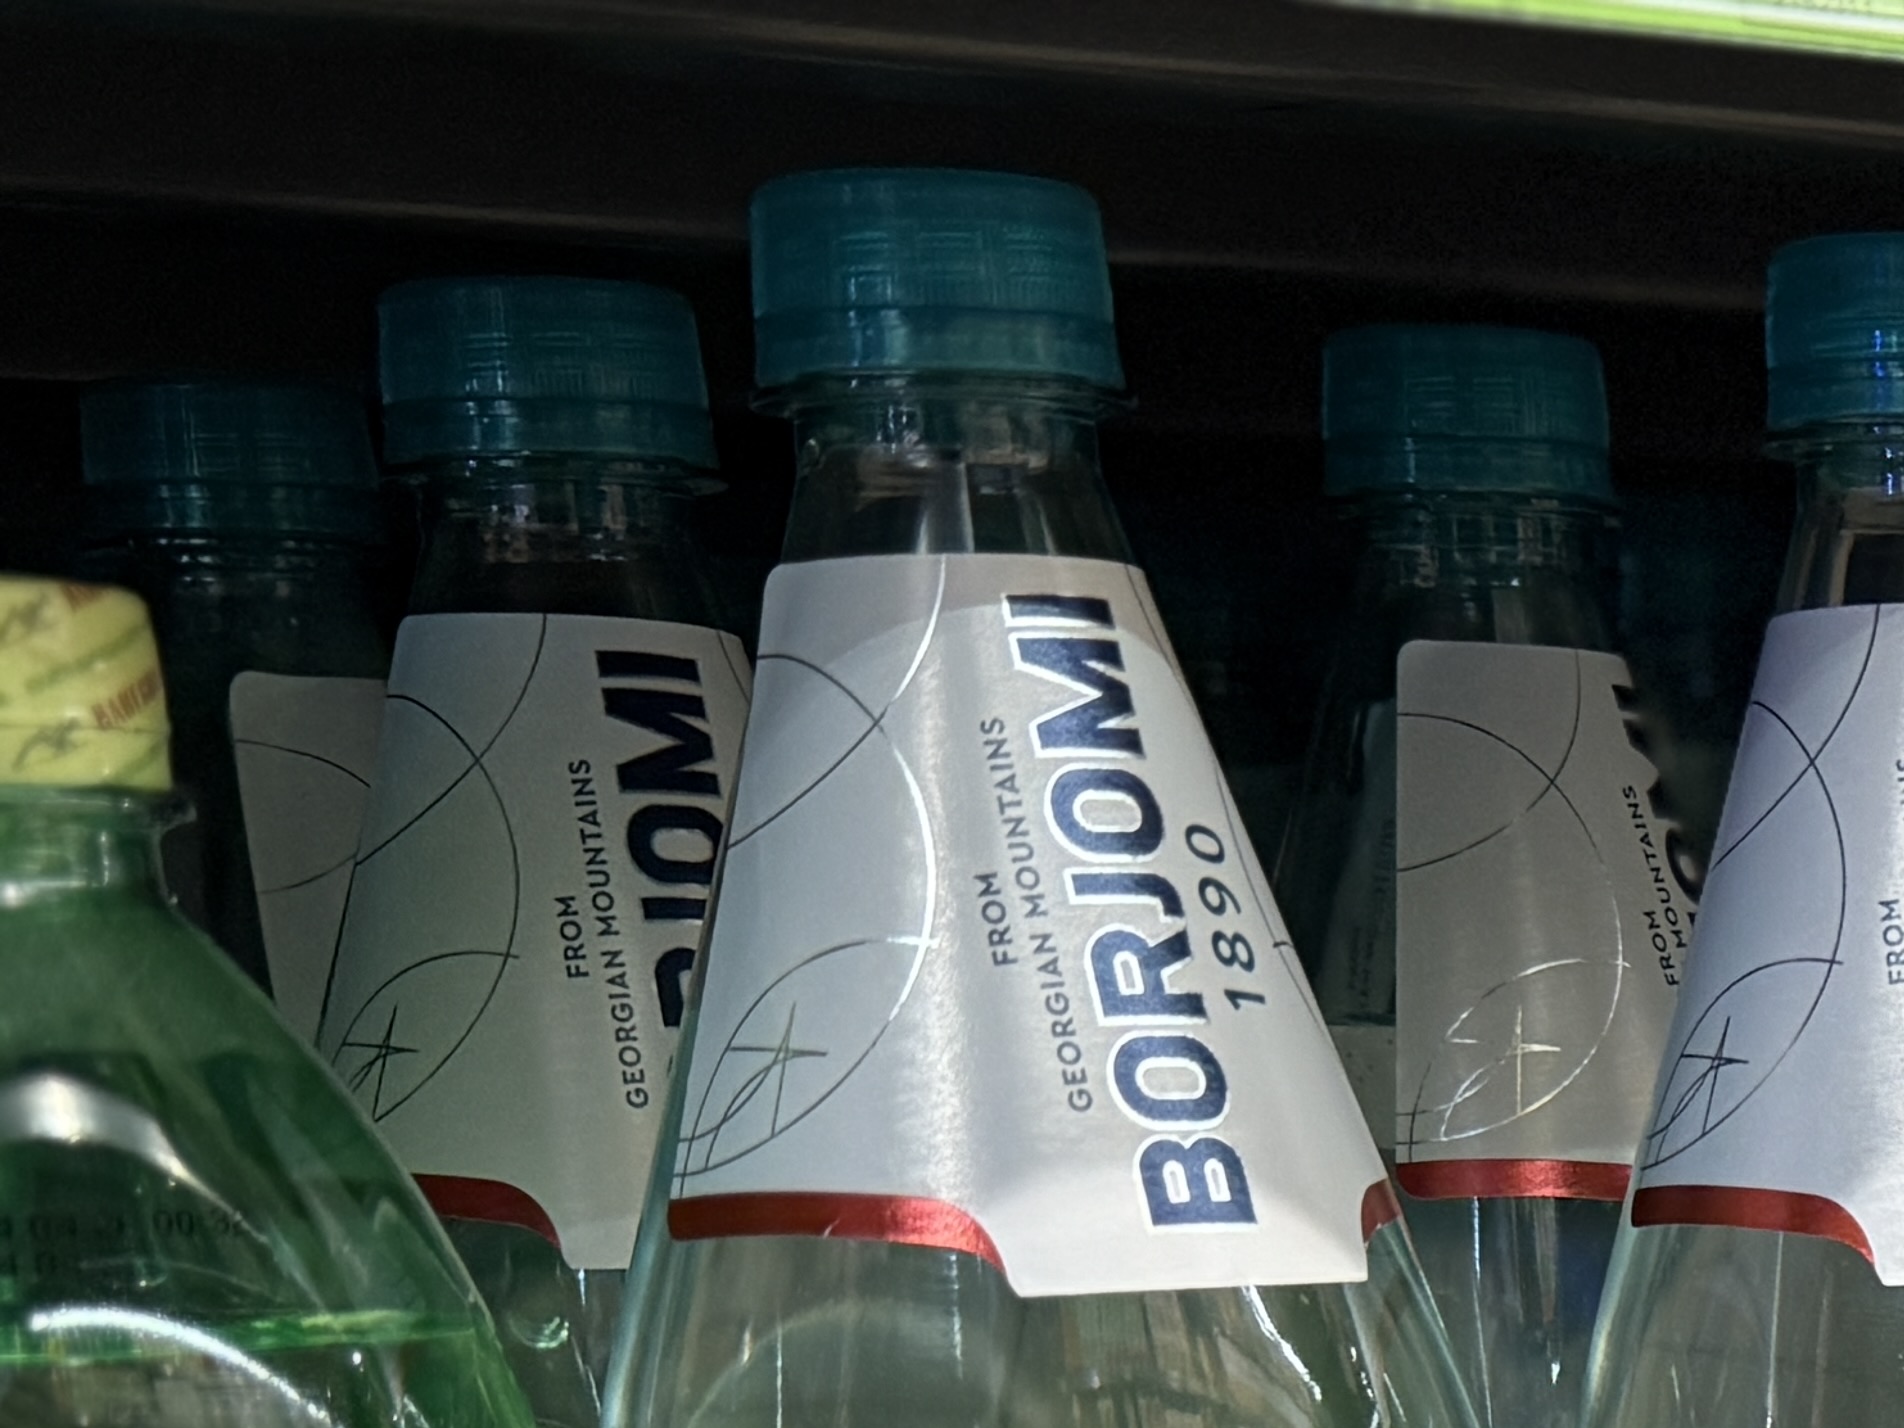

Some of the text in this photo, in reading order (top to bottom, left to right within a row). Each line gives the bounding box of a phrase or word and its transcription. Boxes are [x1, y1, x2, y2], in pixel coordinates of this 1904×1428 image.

[555, 896, 589, 979] FROM
[567, 757, 650, 1110] GEORGIAN MOUNTAINS
[973, 871, 1015, 968] FROM
[979, 716, 1093, 1113] GEORGIAN MOUNTAINS
[1003, 593, 1259, 1233] BORJOMI
[1185, 823, 1266, 1013] 1890
[1622, 785, 1689, 949] MOUNTAINS
[1643, 910, 1680, 988] FROM
